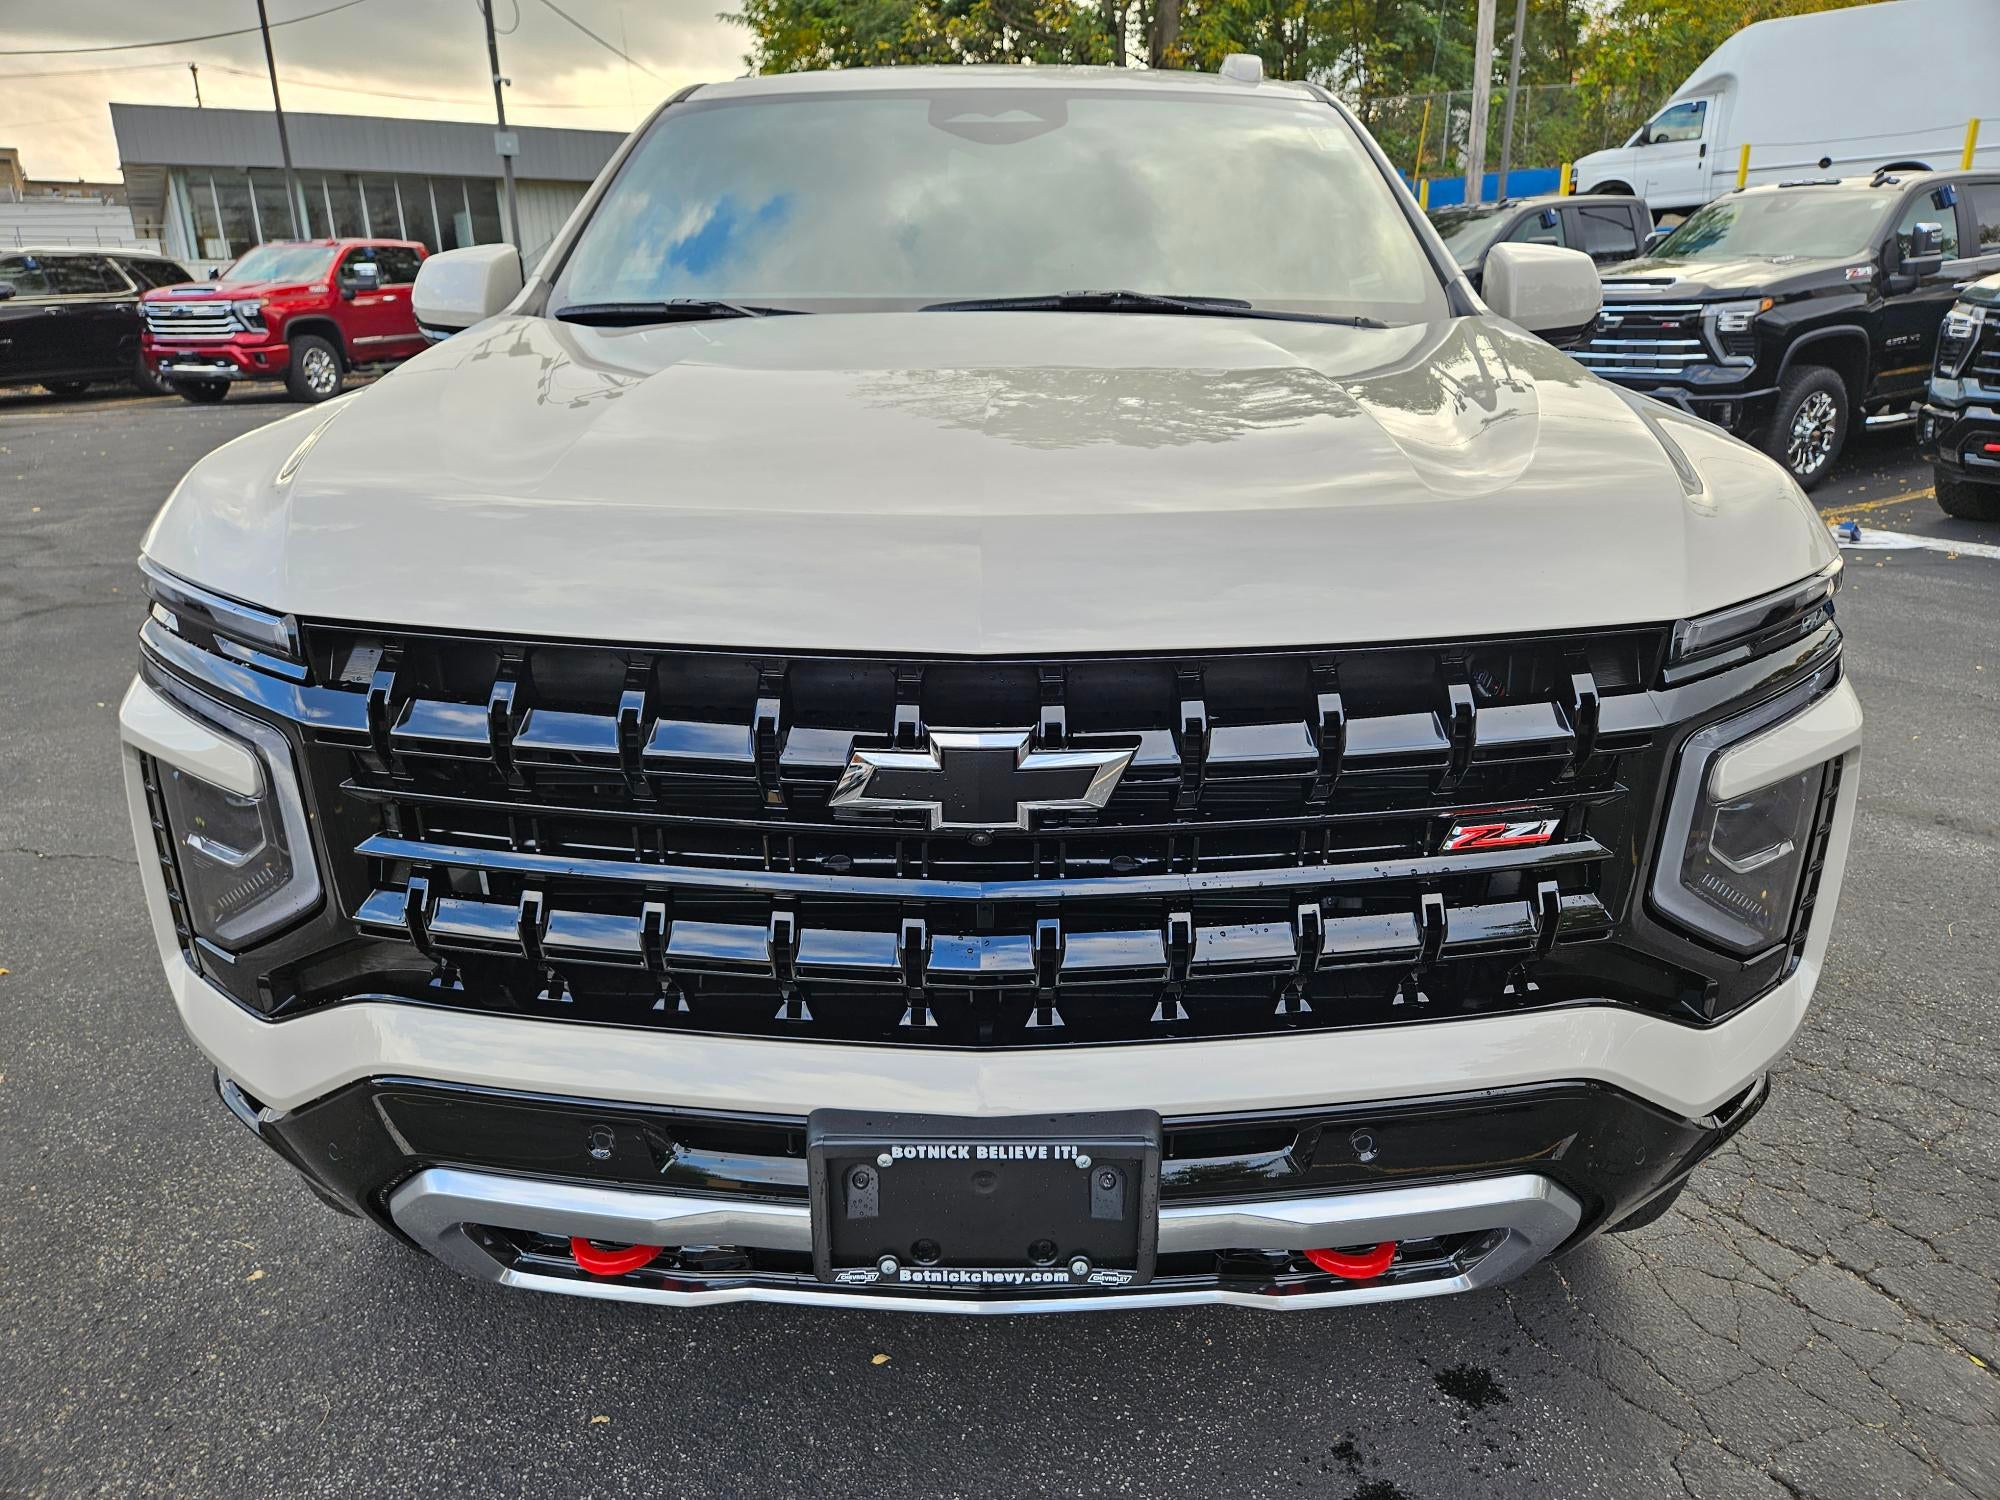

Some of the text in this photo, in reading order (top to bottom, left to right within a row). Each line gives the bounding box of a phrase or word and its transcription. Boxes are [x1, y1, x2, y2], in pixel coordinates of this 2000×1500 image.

[891, 1145, 1078, 1160] BOTNICK BELIEVE IT!
[899, 1269, 1069, 1284] Botnickchevy.com
